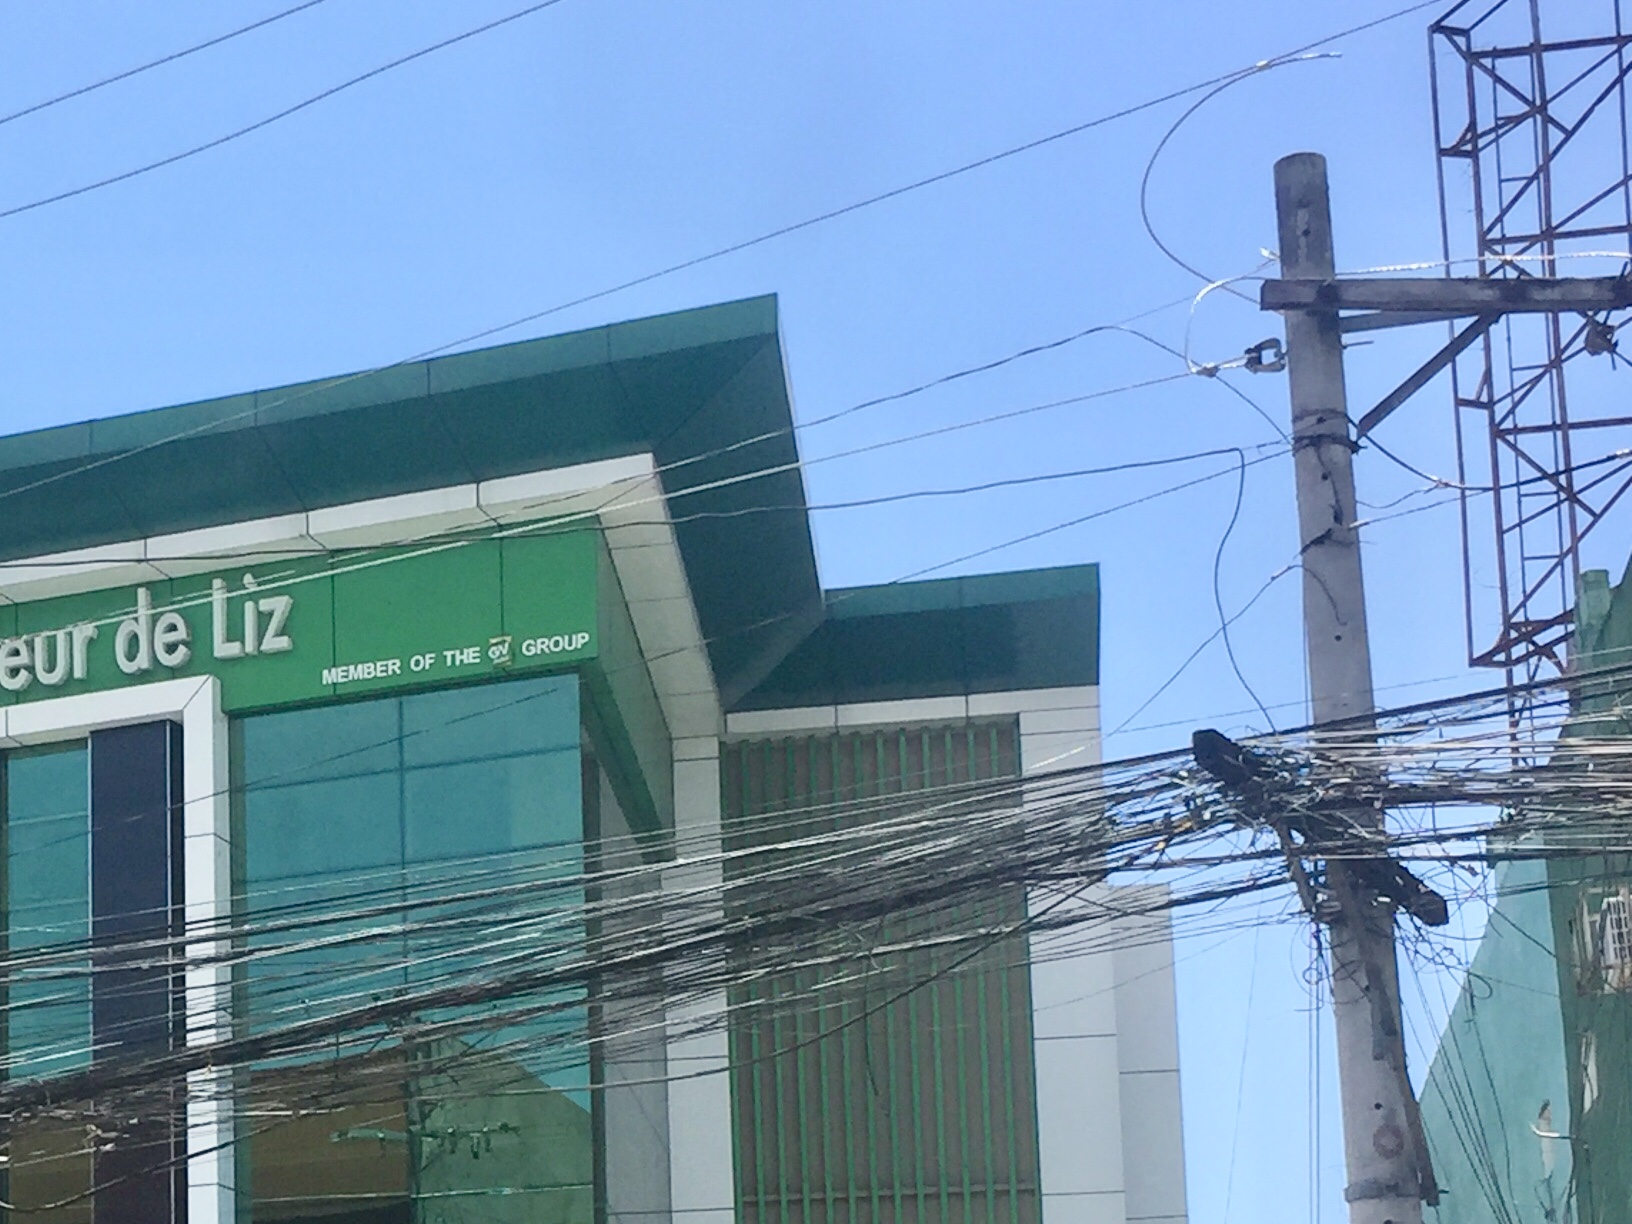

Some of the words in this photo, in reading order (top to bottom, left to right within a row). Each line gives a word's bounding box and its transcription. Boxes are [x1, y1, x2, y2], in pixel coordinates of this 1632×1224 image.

[115, 587, 192, 675] de
[212, 573, 294, 659] Liz
[321, 658, 402, 685] MEMBER
[410, 653, 436, 672] OF
[443, 646, 481, 667] THE
[521, 631, 590, 656] GROUP
